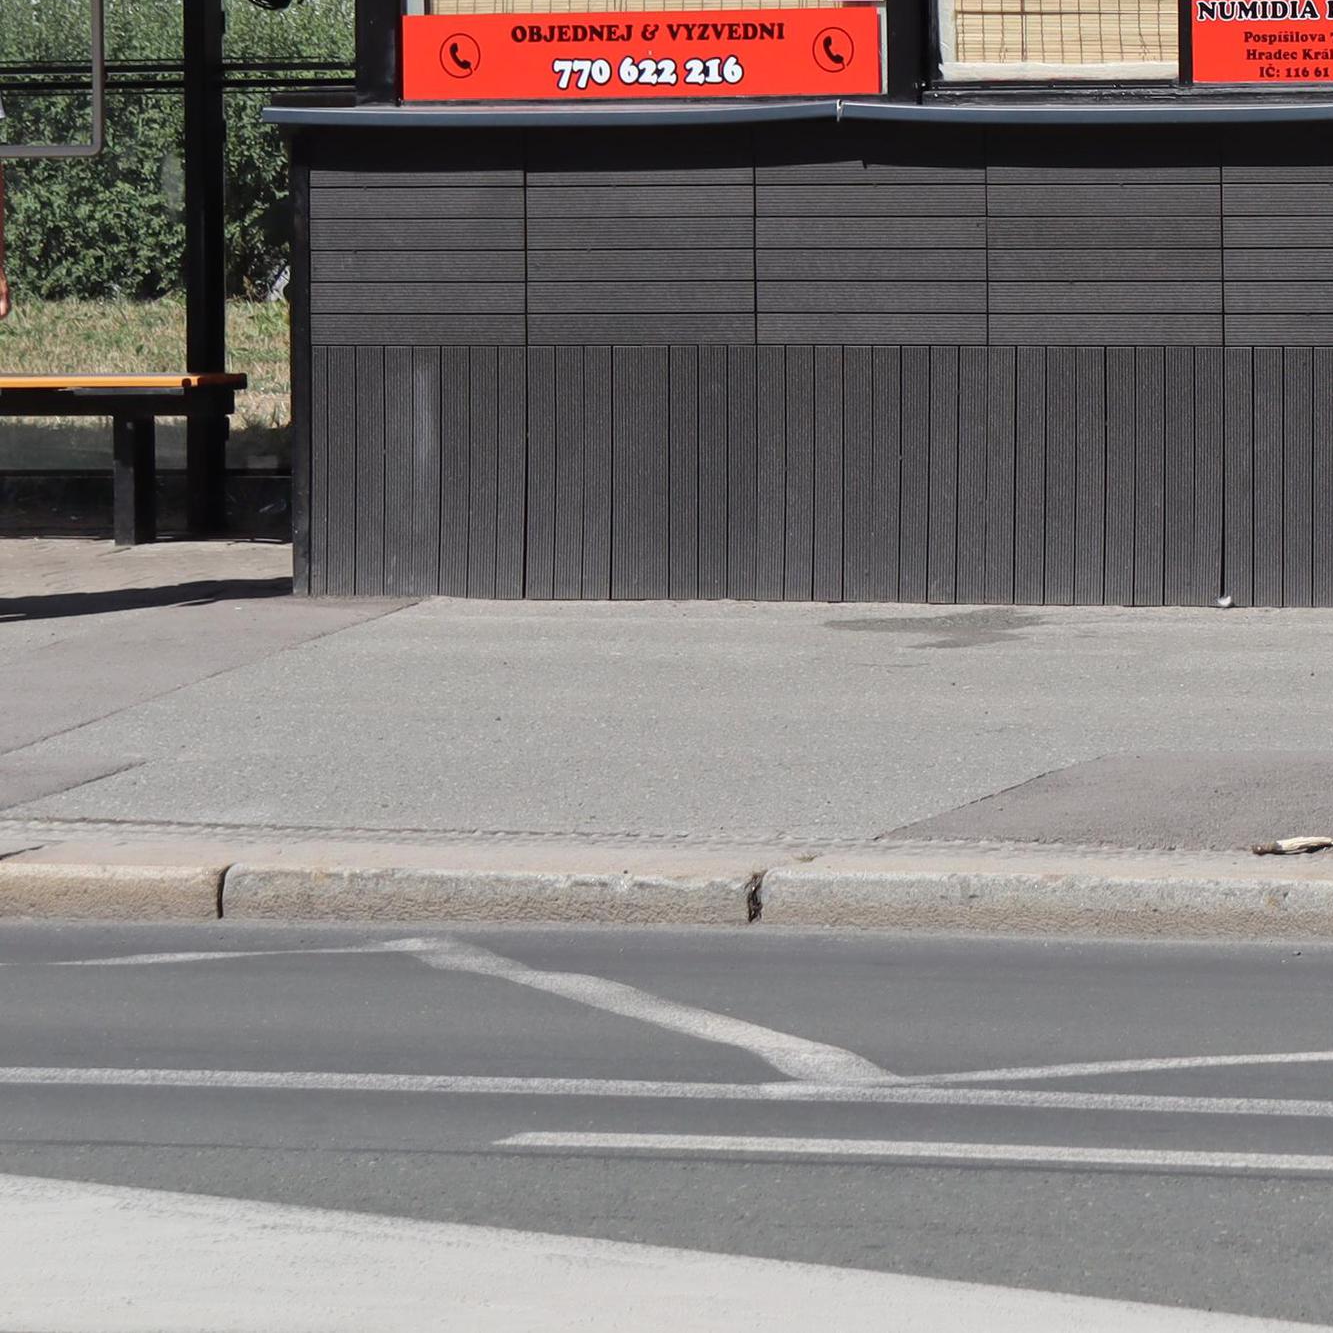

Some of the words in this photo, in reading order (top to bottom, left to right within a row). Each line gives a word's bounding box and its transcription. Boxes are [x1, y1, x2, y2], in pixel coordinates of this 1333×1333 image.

[511, 25, 633, 44] OBJEDNEJ
[641, 24, 660, 42] &
[667, 22, 785, 41] VYZVEDNI
[1243, 31, 1326, 46] Pospíšilova
[1246, 49, 1298, 60] Hradec
[553, 59, 611, 90] 770
[617, 56, 677, 87] 622
[684, 54, 743, 86] 216
[1285, 67, 1310, 78] 116
[1314, 67, 1330, 77] 61
